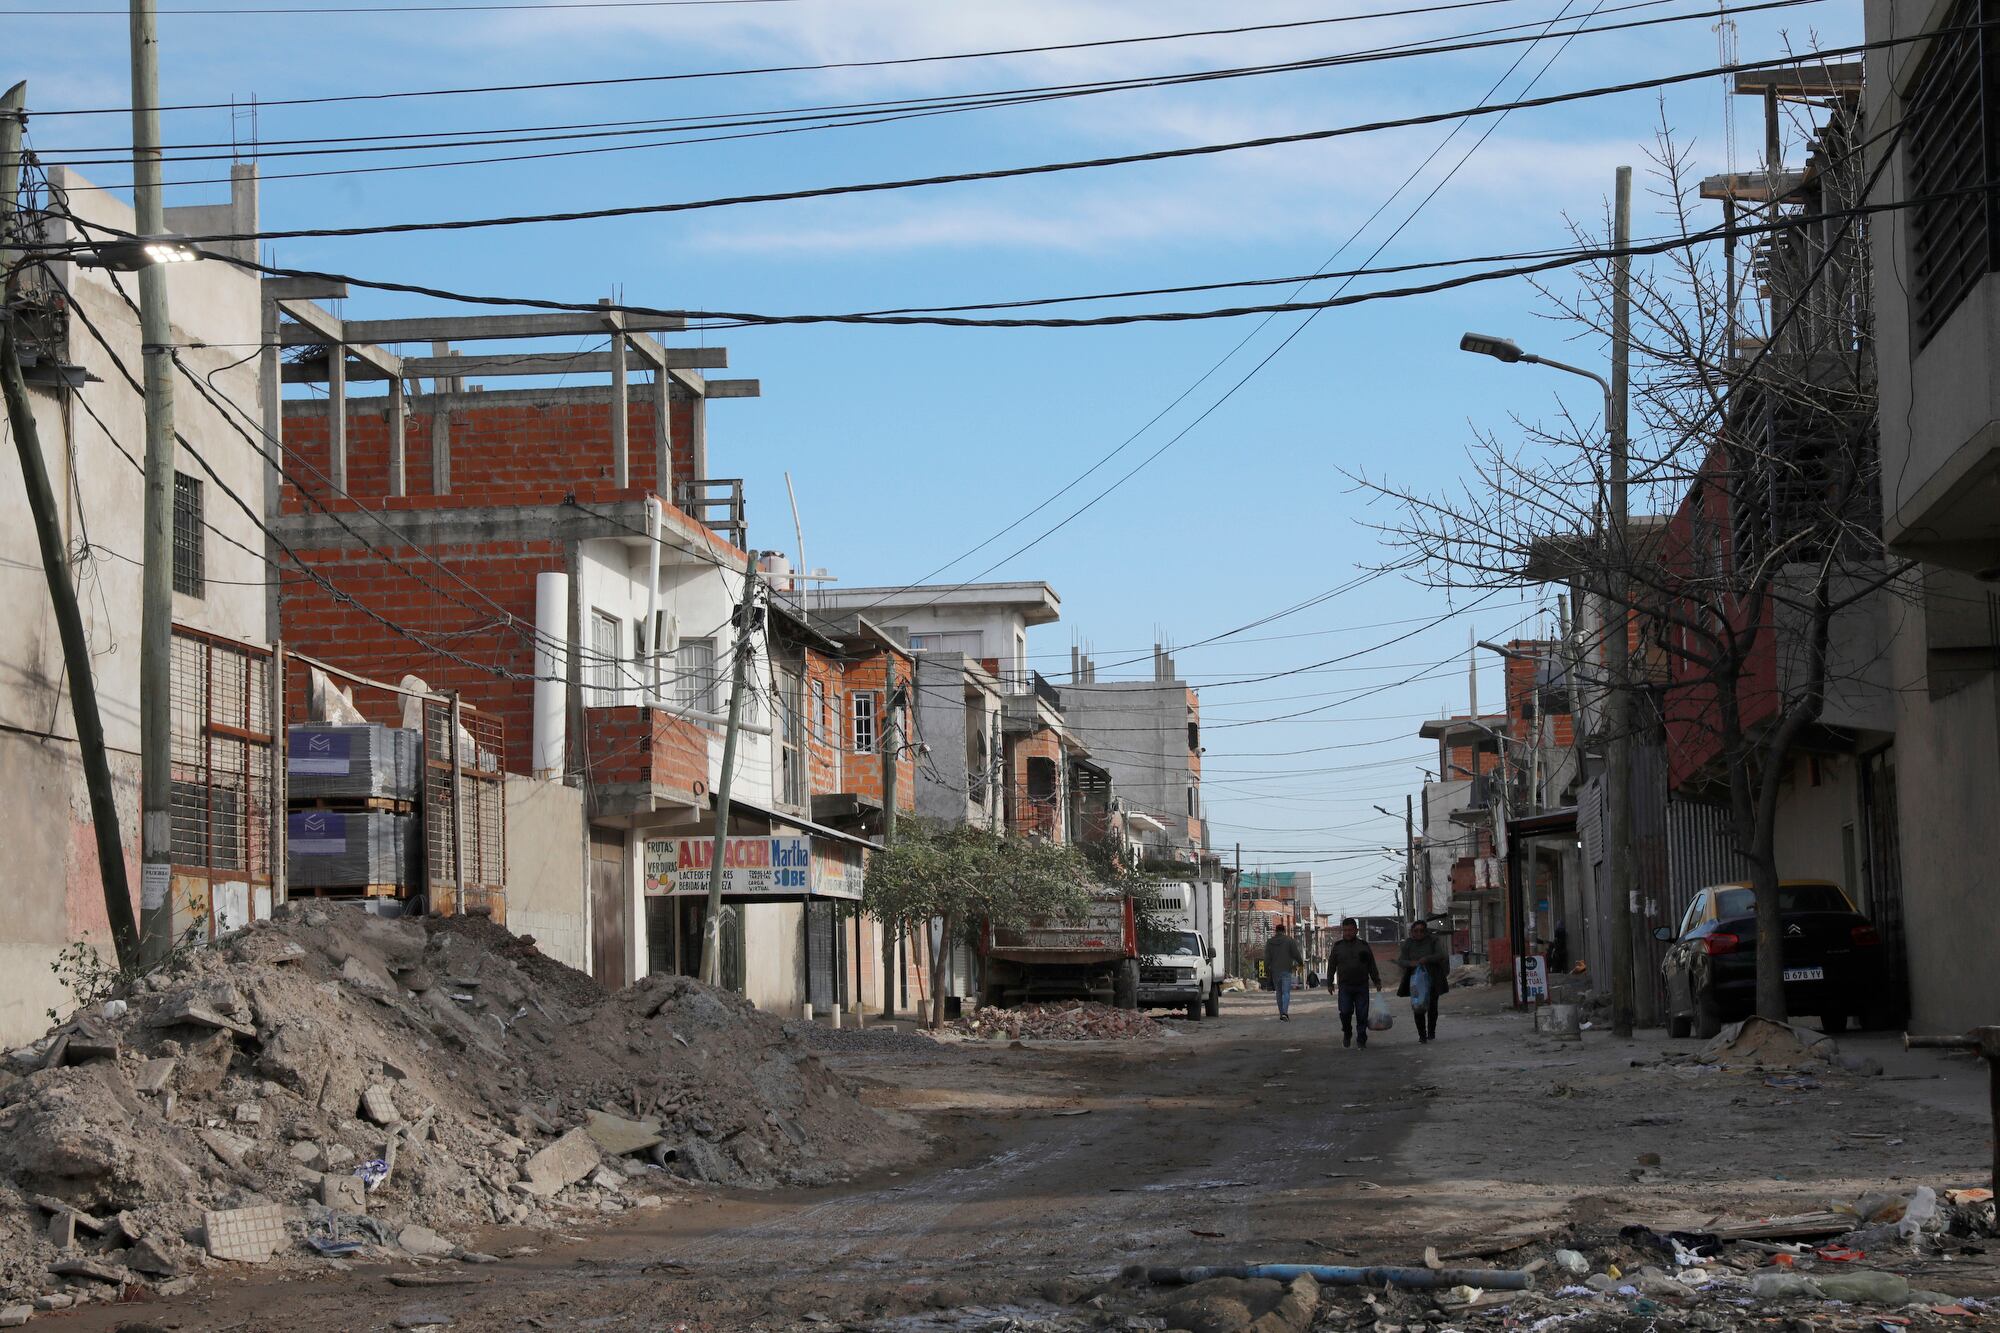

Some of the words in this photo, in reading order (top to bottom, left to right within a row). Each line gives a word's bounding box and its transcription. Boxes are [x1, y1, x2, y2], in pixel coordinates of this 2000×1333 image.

[647, 841, 674, 853] FRUTAS
[657, 853, 662, 861] Y
[771, 840, 808, 867] Martha
[647, 861, 677, 873] VERDURAS
[679, 881, 700, 891] BEBIDAS
